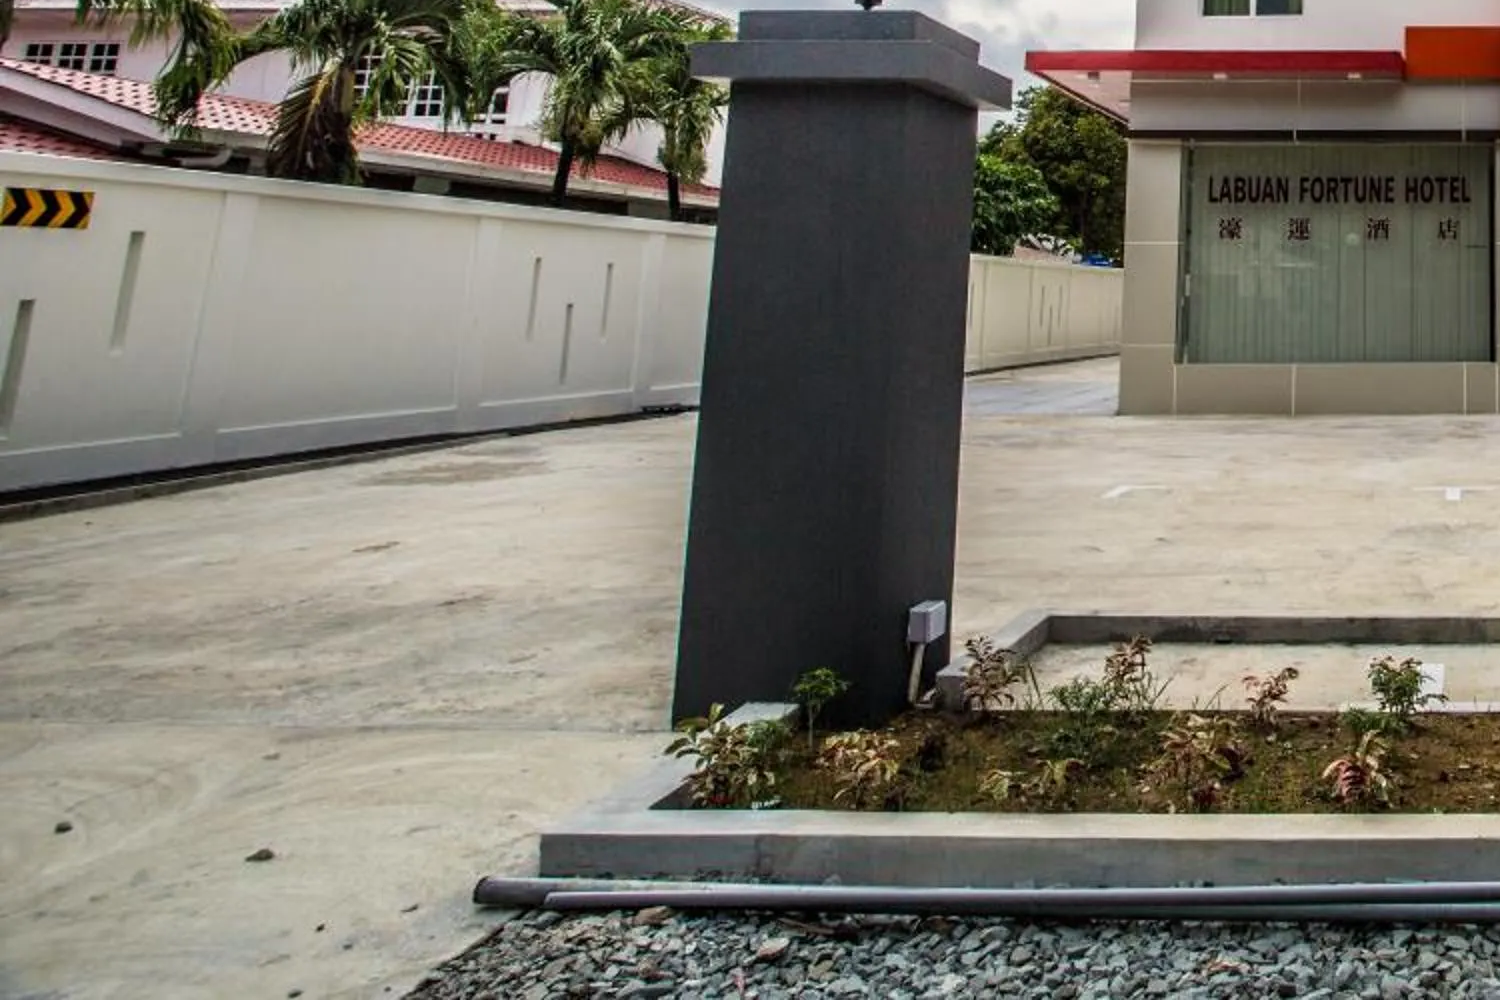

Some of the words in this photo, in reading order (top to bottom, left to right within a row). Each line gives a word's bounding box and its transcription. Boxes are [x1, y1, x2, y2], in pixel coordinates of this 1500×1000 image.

[1208, 175, 1289, 204] LABUAN
[1300, 176, 1394, 204] FORTUNE
[1405, 176, 1471, 204] HOTEL
